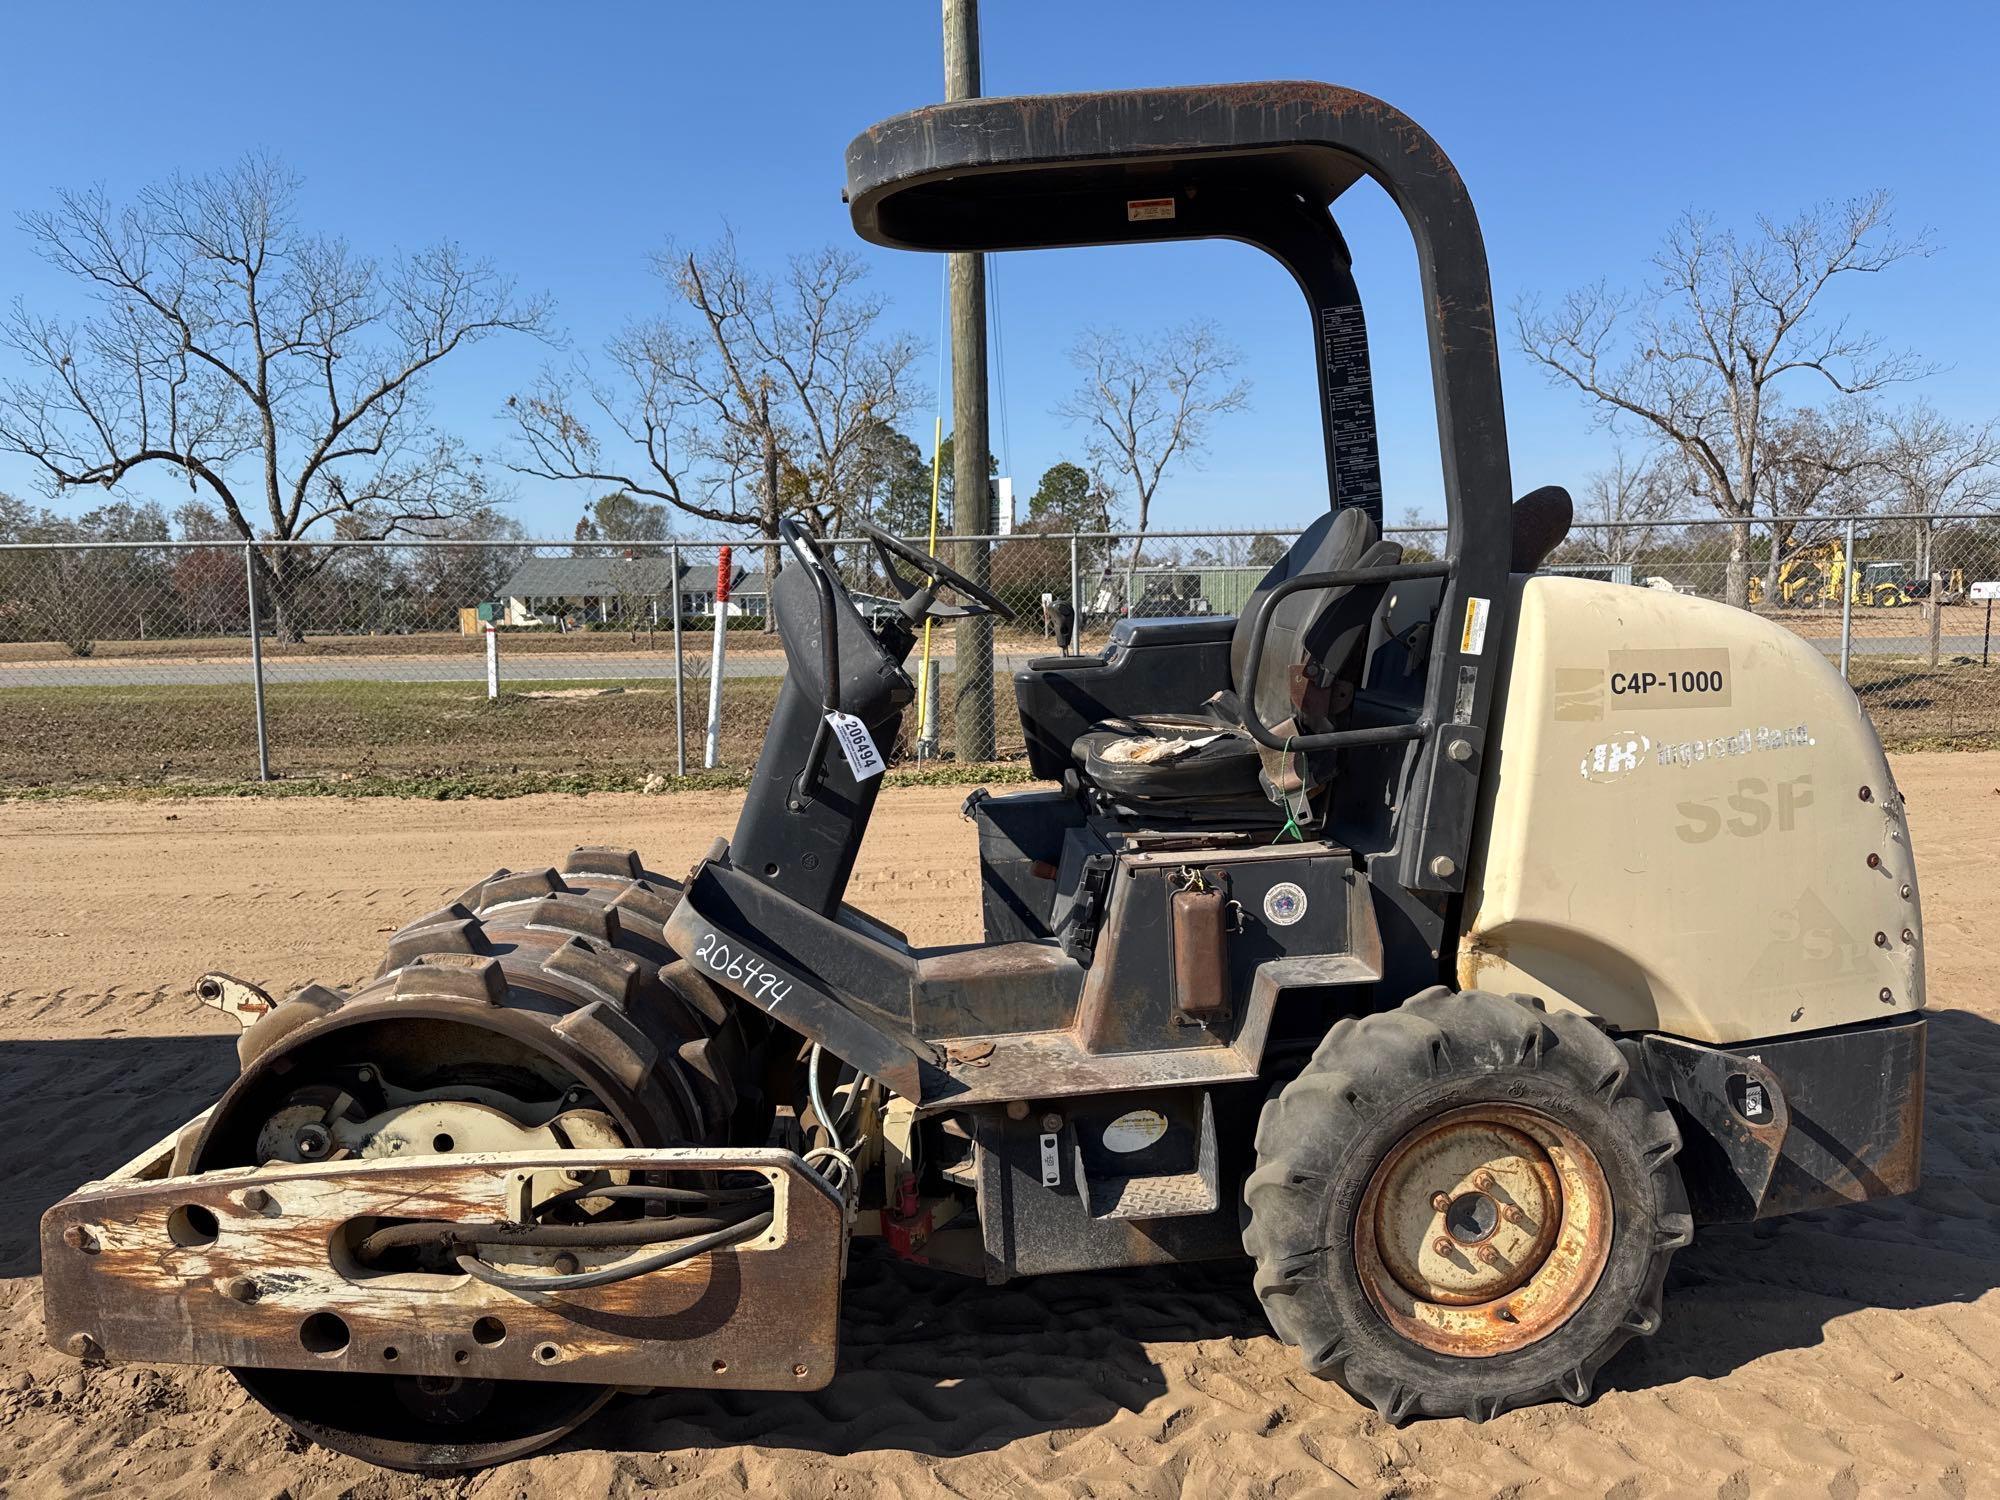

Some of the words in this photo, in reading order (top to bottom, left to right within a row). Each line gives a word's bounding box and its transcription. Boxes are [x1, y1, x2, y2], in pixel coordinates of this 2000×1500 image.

[1610, 670, 1723, 695] C4P-1000
[844, 721, 877, 768] 206494
[695, 933, 793, 1012] 206494
